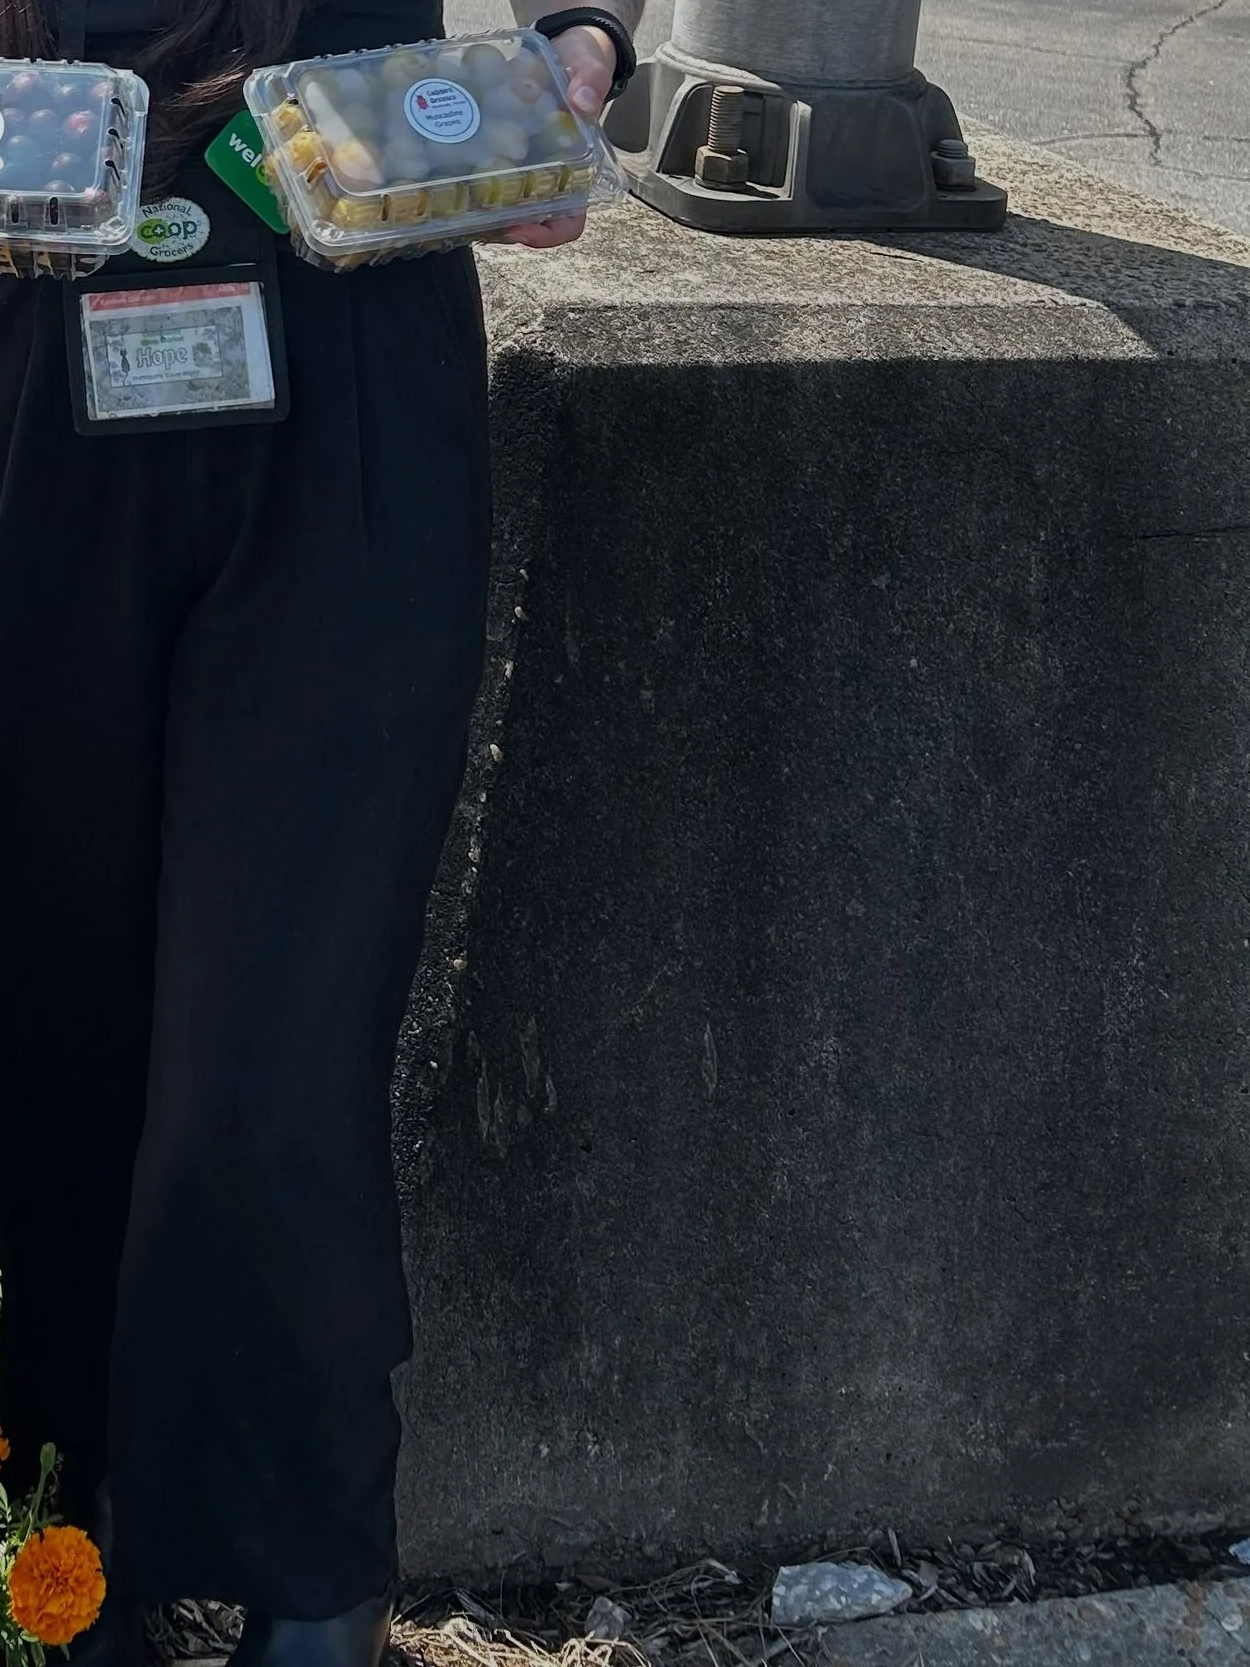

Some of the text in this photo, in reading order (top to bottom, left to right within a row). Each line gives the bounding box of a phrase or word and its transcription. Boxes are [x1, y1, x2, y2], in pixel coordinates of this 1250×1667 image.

[142, 204, 192, 218] National
[150, 244, 194, 257] Grocers
[136, 346, 188, 370] Hope
